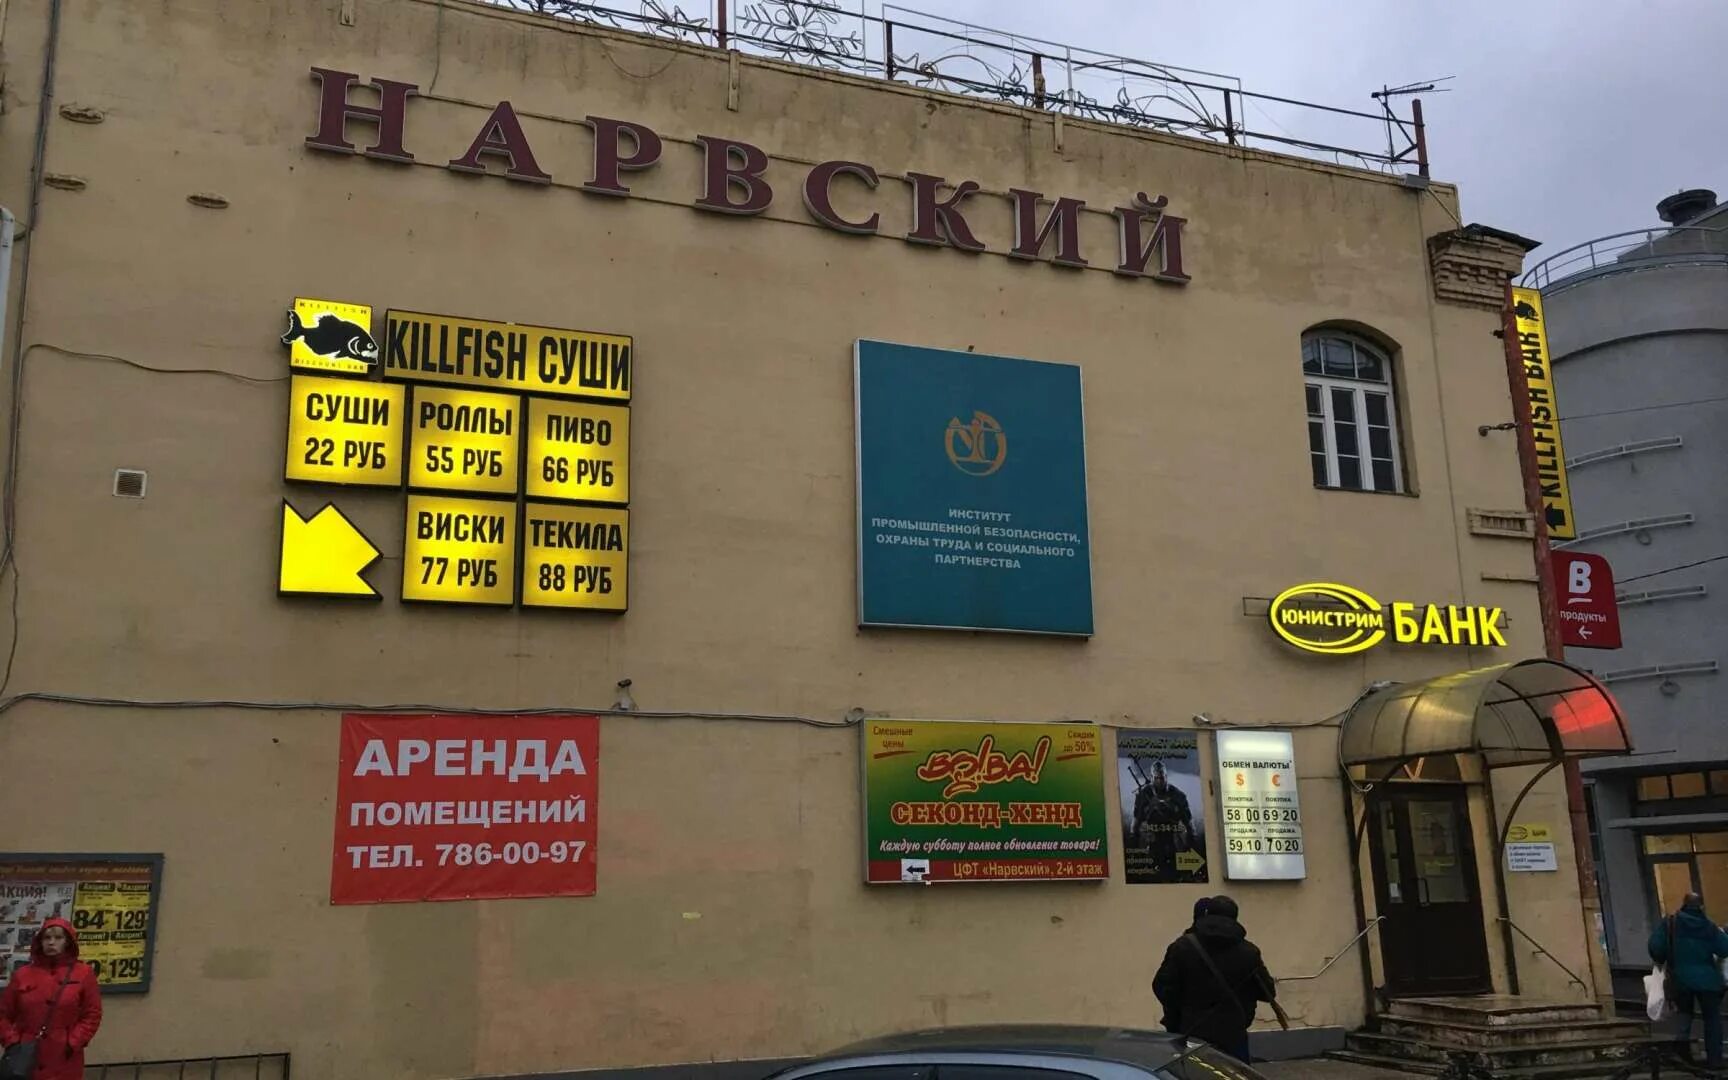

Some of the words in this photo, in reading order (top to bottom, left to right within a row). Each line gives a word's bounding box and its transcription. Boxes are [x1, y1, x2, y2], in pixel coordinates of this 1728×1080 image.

[305, 66, 1193, 285] НАРВСКИЙ
[386, 318, 528, 381] KILLFISH
[537, 336, 631, 391] СУШИ
[1519, 332, 1545, 380] BAR
[305, 393, 389, 426] СУШИ
[419, 401, 513, 436] РОЛЛЫ
[546, 414, 612, 446] ПИВО
[1528, 387, 1562, 498] KILLFISH
[304, 437, 334, 466] 22
[343, 440, 386, 470] РУБ
[426, 445, 454, 473] 55
[462, 449, 503, 477] РУБ
[542, 456, 569, 484] 66
[576, 459, 614, 487] РУБ
[417, 511, 505, 544] ВИСКИ
[949, 508, 1011, 523] ИНСТИТУТ
[529, 519, 624, 552] ТЕКИЛА
[872, 518, 981, 536] ПРОМЫШЛЕННОЙ
[984, 525, 1081, 544] БЕЗОПАСНОСТИ,
[876, 533, 929, 547] ОХРАНЫ
[933, 538, 971, 551] ТРУДА
[974, 542, 984, 552] И
[987, 542, 1075, 558] СОЦИАЛЬНОГО
[420, 556, 449, 585] 77
[457, 559, 498, 588] РУБ
[935, 554, 1021, 569] ПАРТНЕРСТВА
[539, 563, 565, 592] 88
[573, 566, 612, 594] РУБ
[1281, 608, 1384, 629] ЮНИСТРИМ
[1391, 601, 1508, 647] БАНК
[1560, 609, 1607, 623] продукты
[873, 726, 913, 736] Смешные
[882, 740, 905, 749] цены
[353, 739, 587, 783] АРЕНДА
[1074, 742, 1095, 753] 50%
[1222, 761, 1251, 769] ОБМЕН
[1236, 773, 1245, 786] $
[350, 794, 586, 829] ПОМЕЩЕНИЙ
[891, 801, 1083, 828] СЕКОНД-ХЕНД
[346, 845, 424, 869] ТЕЛ.
[435, 841, 586, 867] 786-00-97
[880, 838, 921, 852] Каждую
[923, 839, 966, 853] субботу
[968, 841, 1002, 851] полное
[1003, 838, 1059, 851] обновление
[1061, 839, 1100, 852] товара!
[953, 863, 979, 878] ЦФТ
[1056, 862, 1074, 875] 2-й
[1076, 864, 1103, 875] этаж
[73, 910, 104, 929] 84
[114, 910, 145, 930] 129
[108, 959, 140, 978] 129
